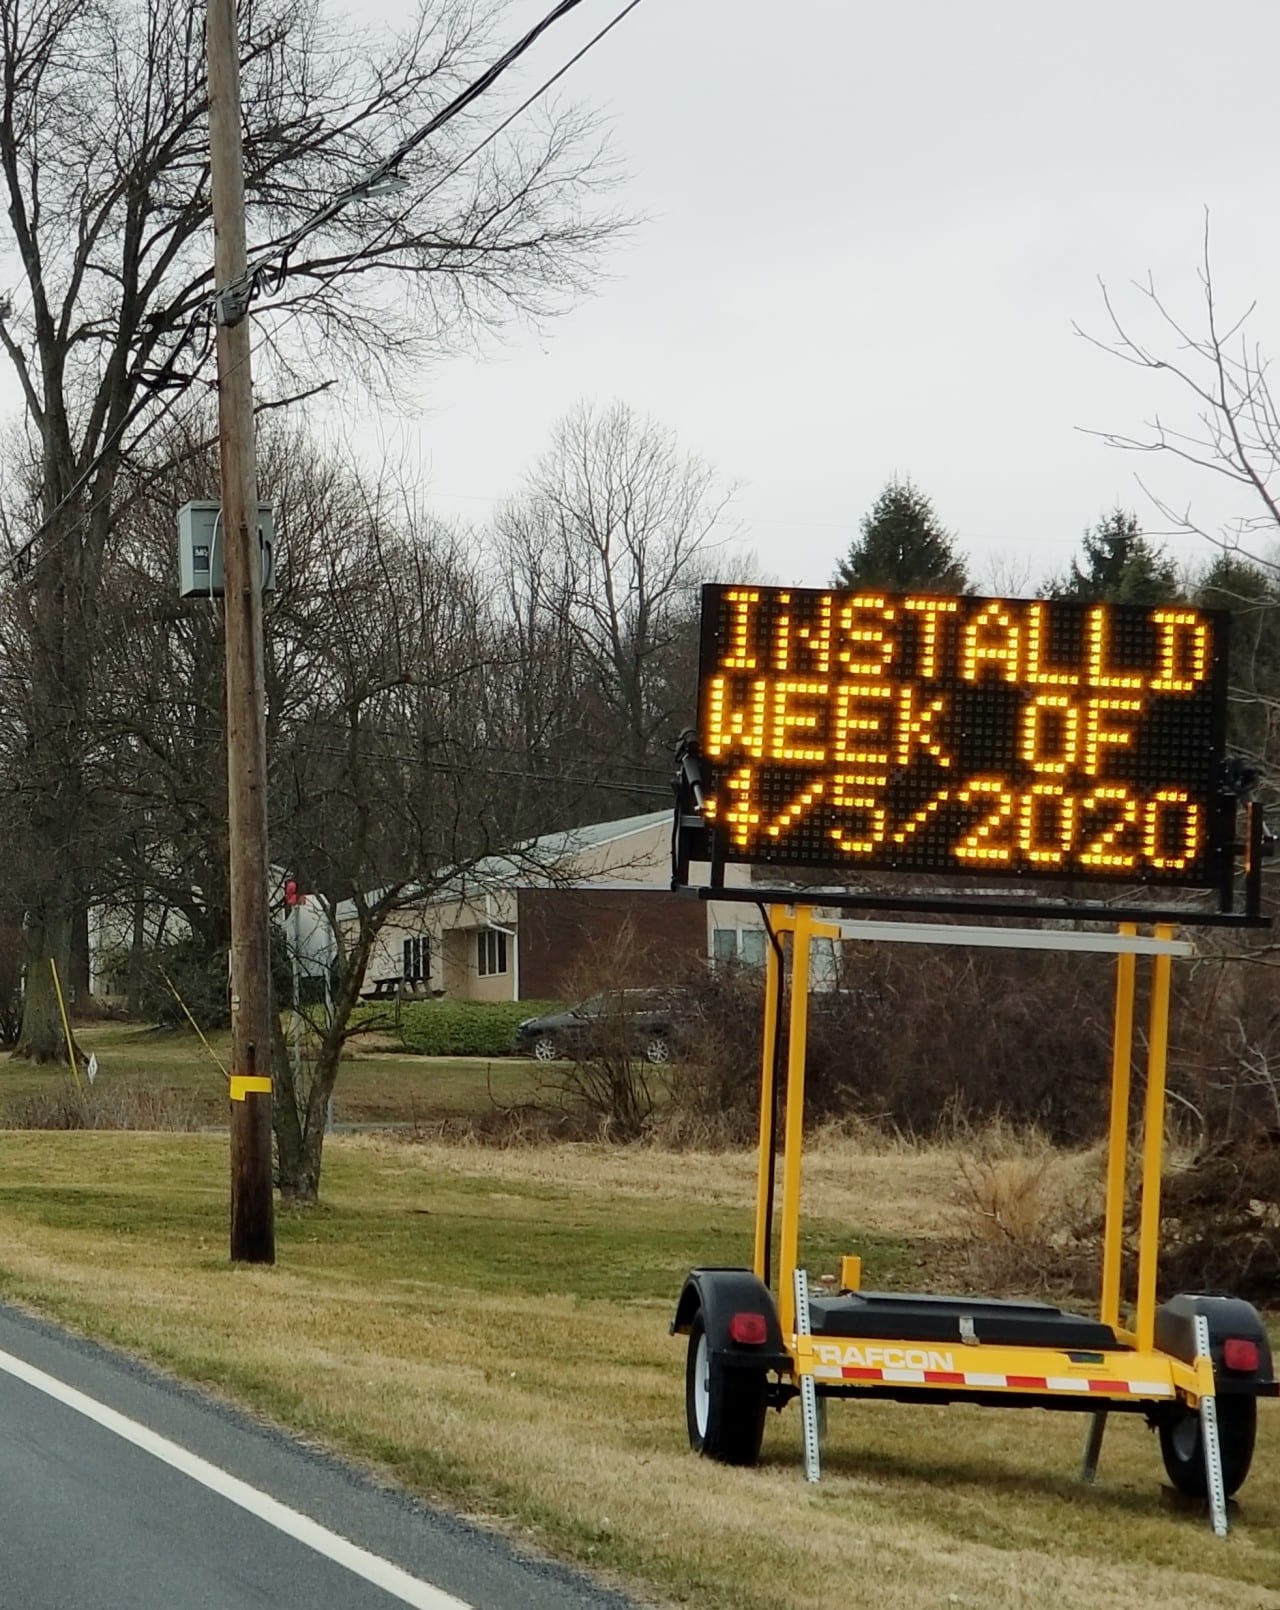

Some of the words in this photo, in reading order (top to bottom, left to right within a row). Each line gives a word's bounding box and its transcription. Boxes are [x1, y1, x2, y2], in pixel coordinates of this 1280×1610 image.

[720, 591, 1208, 691] INSTALLD
[706, 678, 951, 767] WEEK
[1022, 695, 1142, 776] OF
